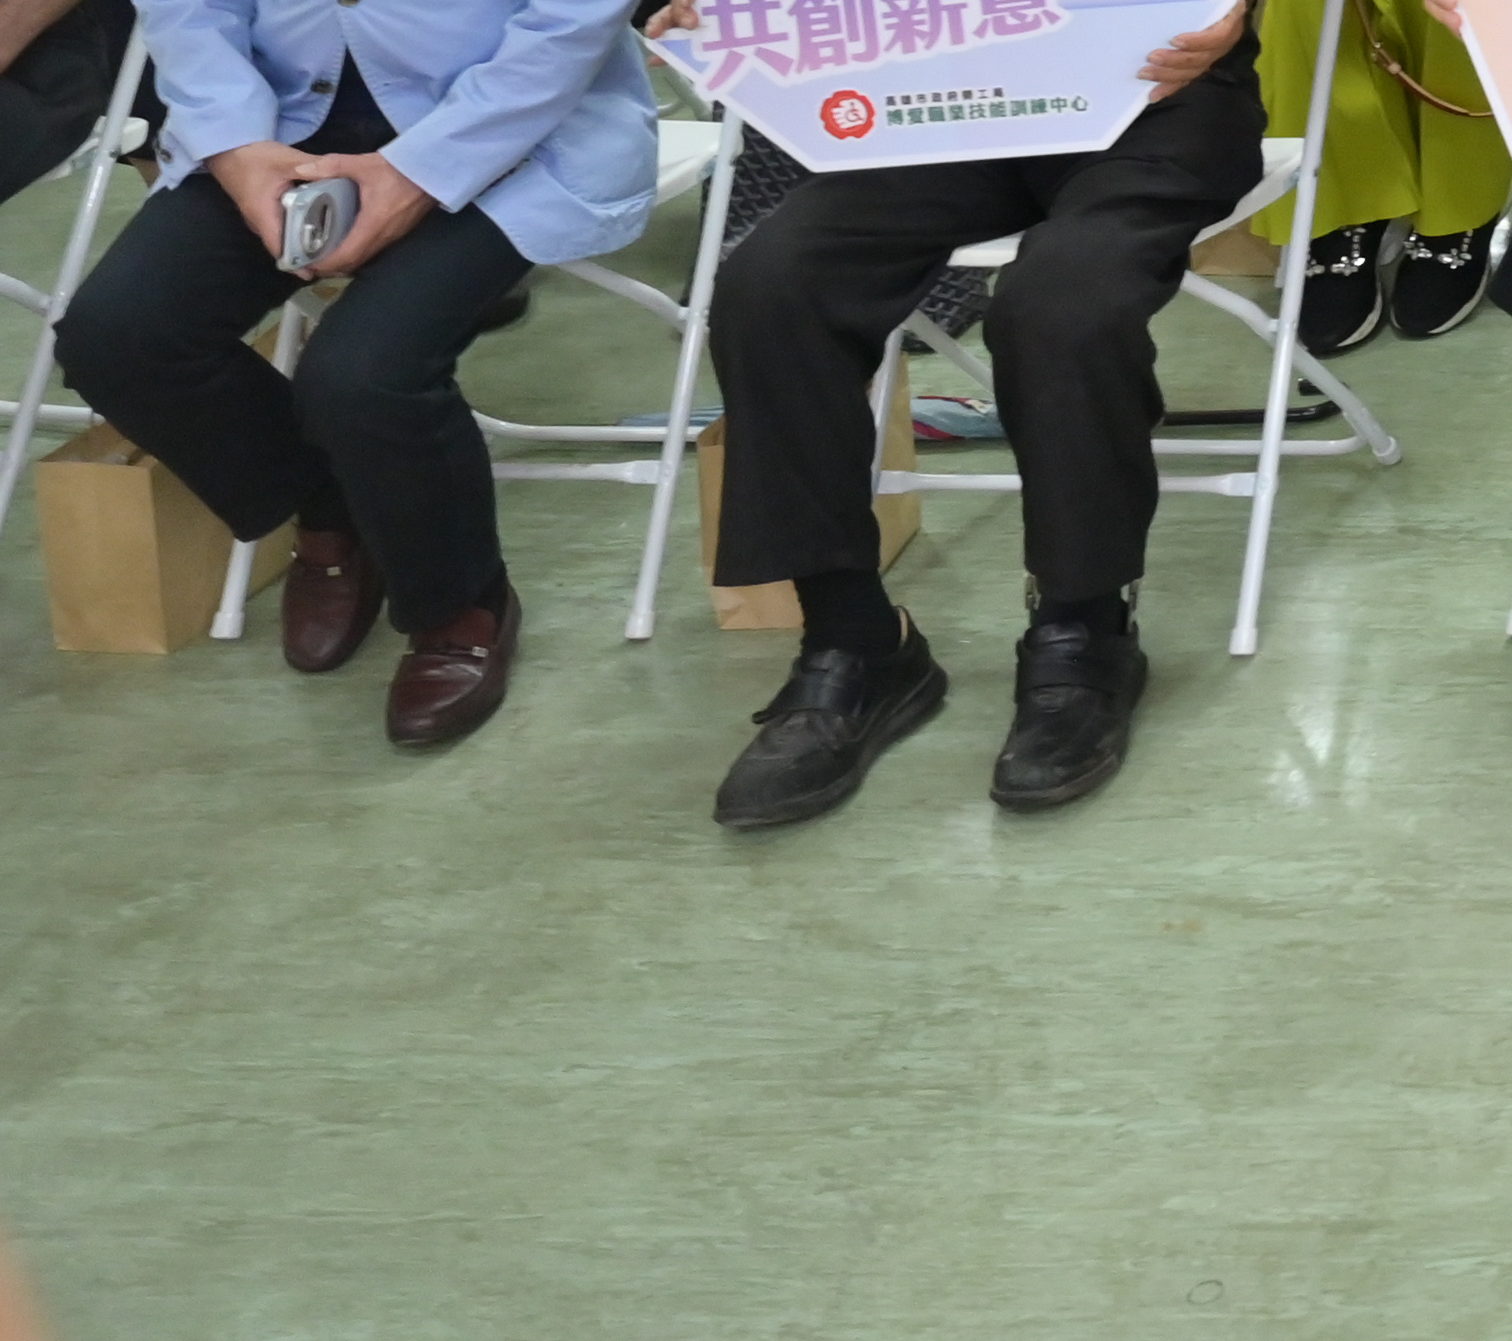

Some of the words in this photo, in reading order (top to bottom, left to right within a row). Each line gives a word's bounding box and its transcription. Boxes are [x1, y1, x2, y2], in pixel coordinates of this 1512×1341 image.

[885, 86, 1005, 109] 高雄市政府勞工局
[885, 94, 1090, 129] 博愛職業技能訓練中心
